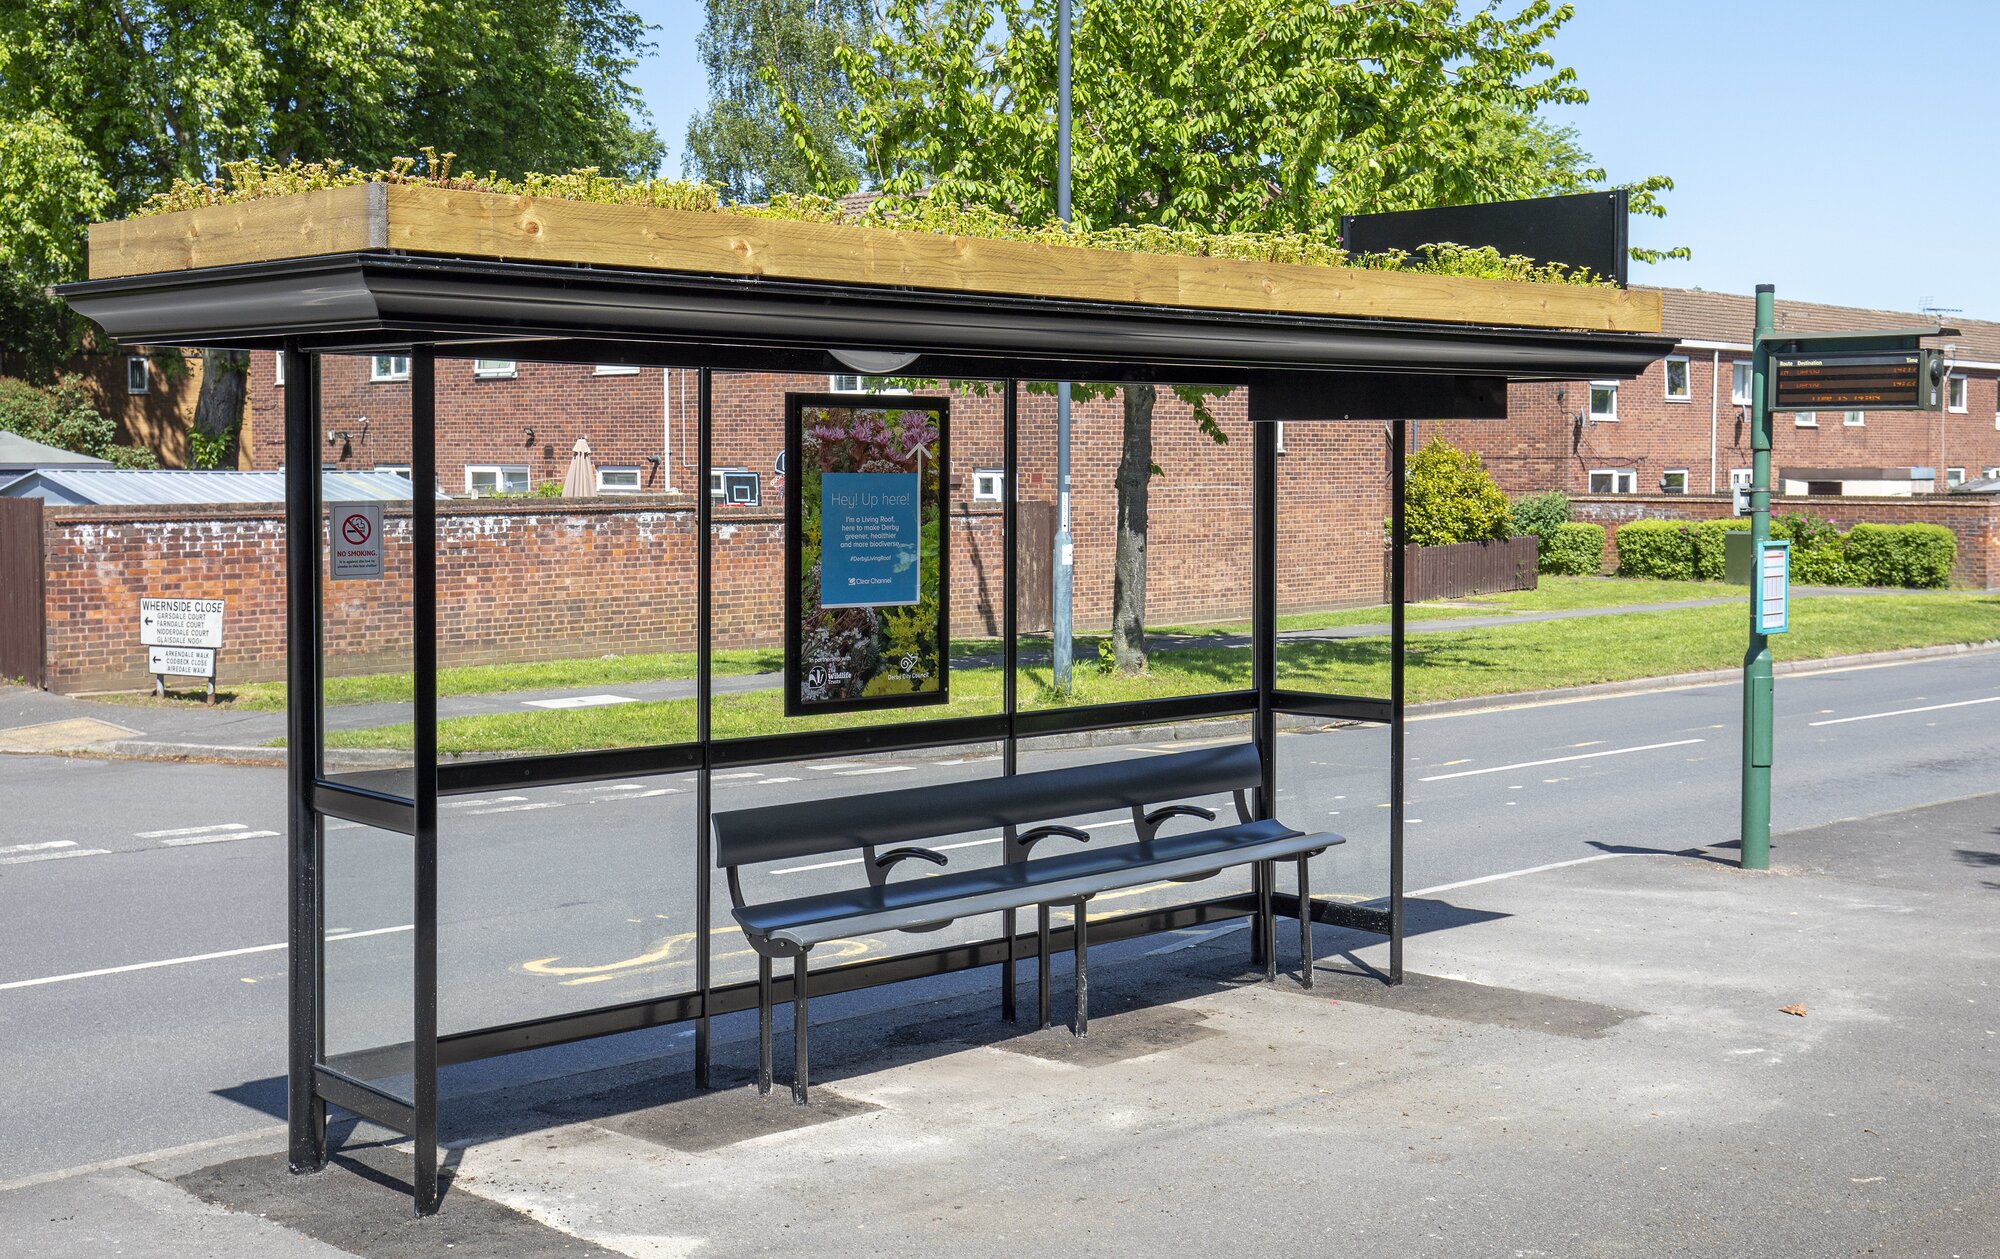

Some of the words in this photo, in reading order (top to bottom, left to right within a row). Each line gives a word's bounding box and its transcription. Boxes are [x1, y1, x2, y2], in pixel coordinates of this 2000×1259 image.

[831, 492, 858, 509] Hey!
[861, 492, 878, 508] Up
[882, 492, 910, 506] here!
[861, 516, 879, 524] Living
[881, 524, 900, 532] Derby
[844, 533, 870, 541] greener,
[142, 600, 192, 612] WHERNSIDE
[194, 602, 223, 613] CLOSE
[156, 612, 186, 620] GARSDALE
[156, 620, 184, 628] FARNDALE
[186, 621, 205, 629] COURT
[156, 628, 189, 636] NIDDERDALE
[190, 629, 209, 637] COURT
[156, 636, 186, 644] GLAISDALE
[187, 637, 203, 645] NOOK
[165, 650, 194, 658] ARKENDALE
[166, 657, 190, 665] CODBECK
[190, 659, 208, 667] CLOSE
[167, 665, 192, 673] AIREDALE
[828, 672, 852, 680] Wildlife
